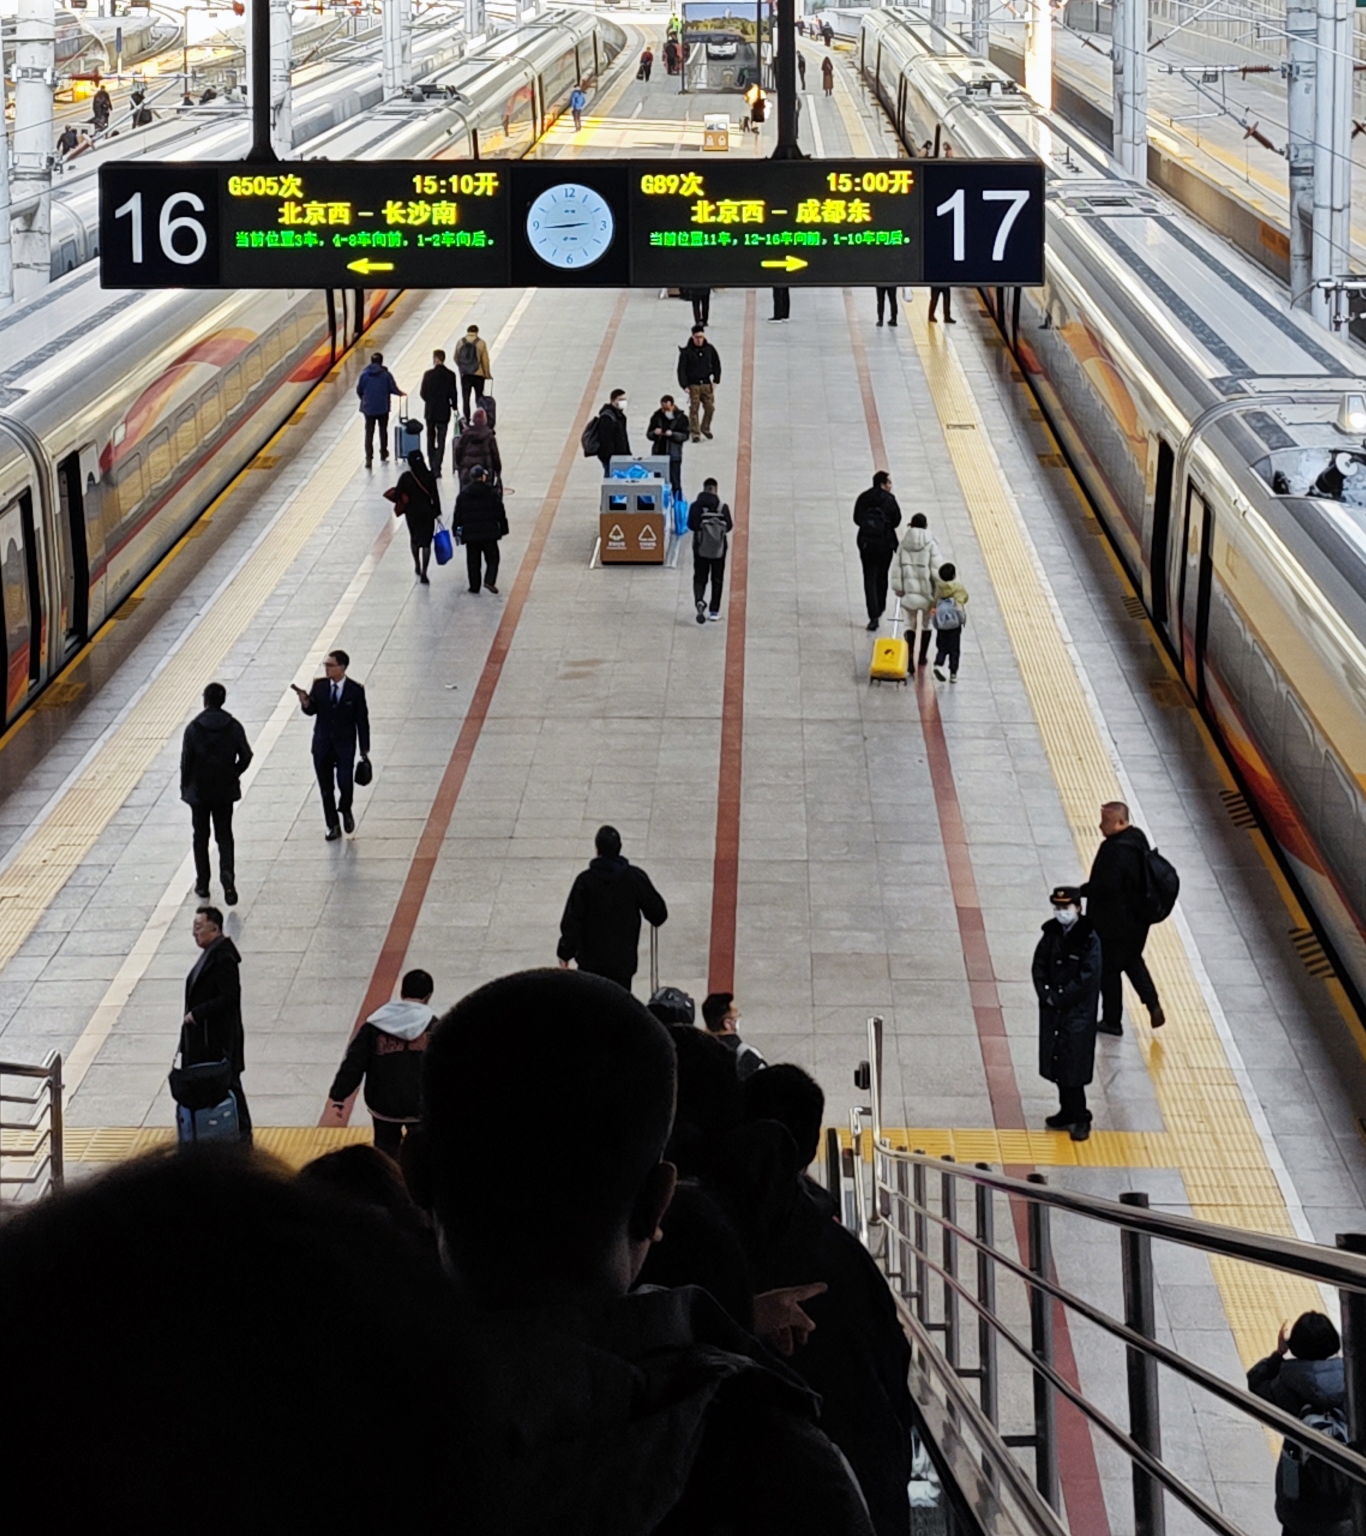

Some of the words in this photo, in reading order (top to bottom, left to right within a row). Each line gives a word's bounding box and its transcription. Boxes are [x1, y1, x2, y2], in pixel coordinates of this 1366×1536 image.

[228, 174, 303, 198] G505次
[413, 173, 498, 196] 15:10开
[564, 187, 575, 198] 12
[641, 172, 704, 196] G89次
[827, 171, 913, 194] 15:00开
[115, 191, 207, 264] 16
[936, 189, 1030, 261] 17
[566, 254, 573, 265] 6
